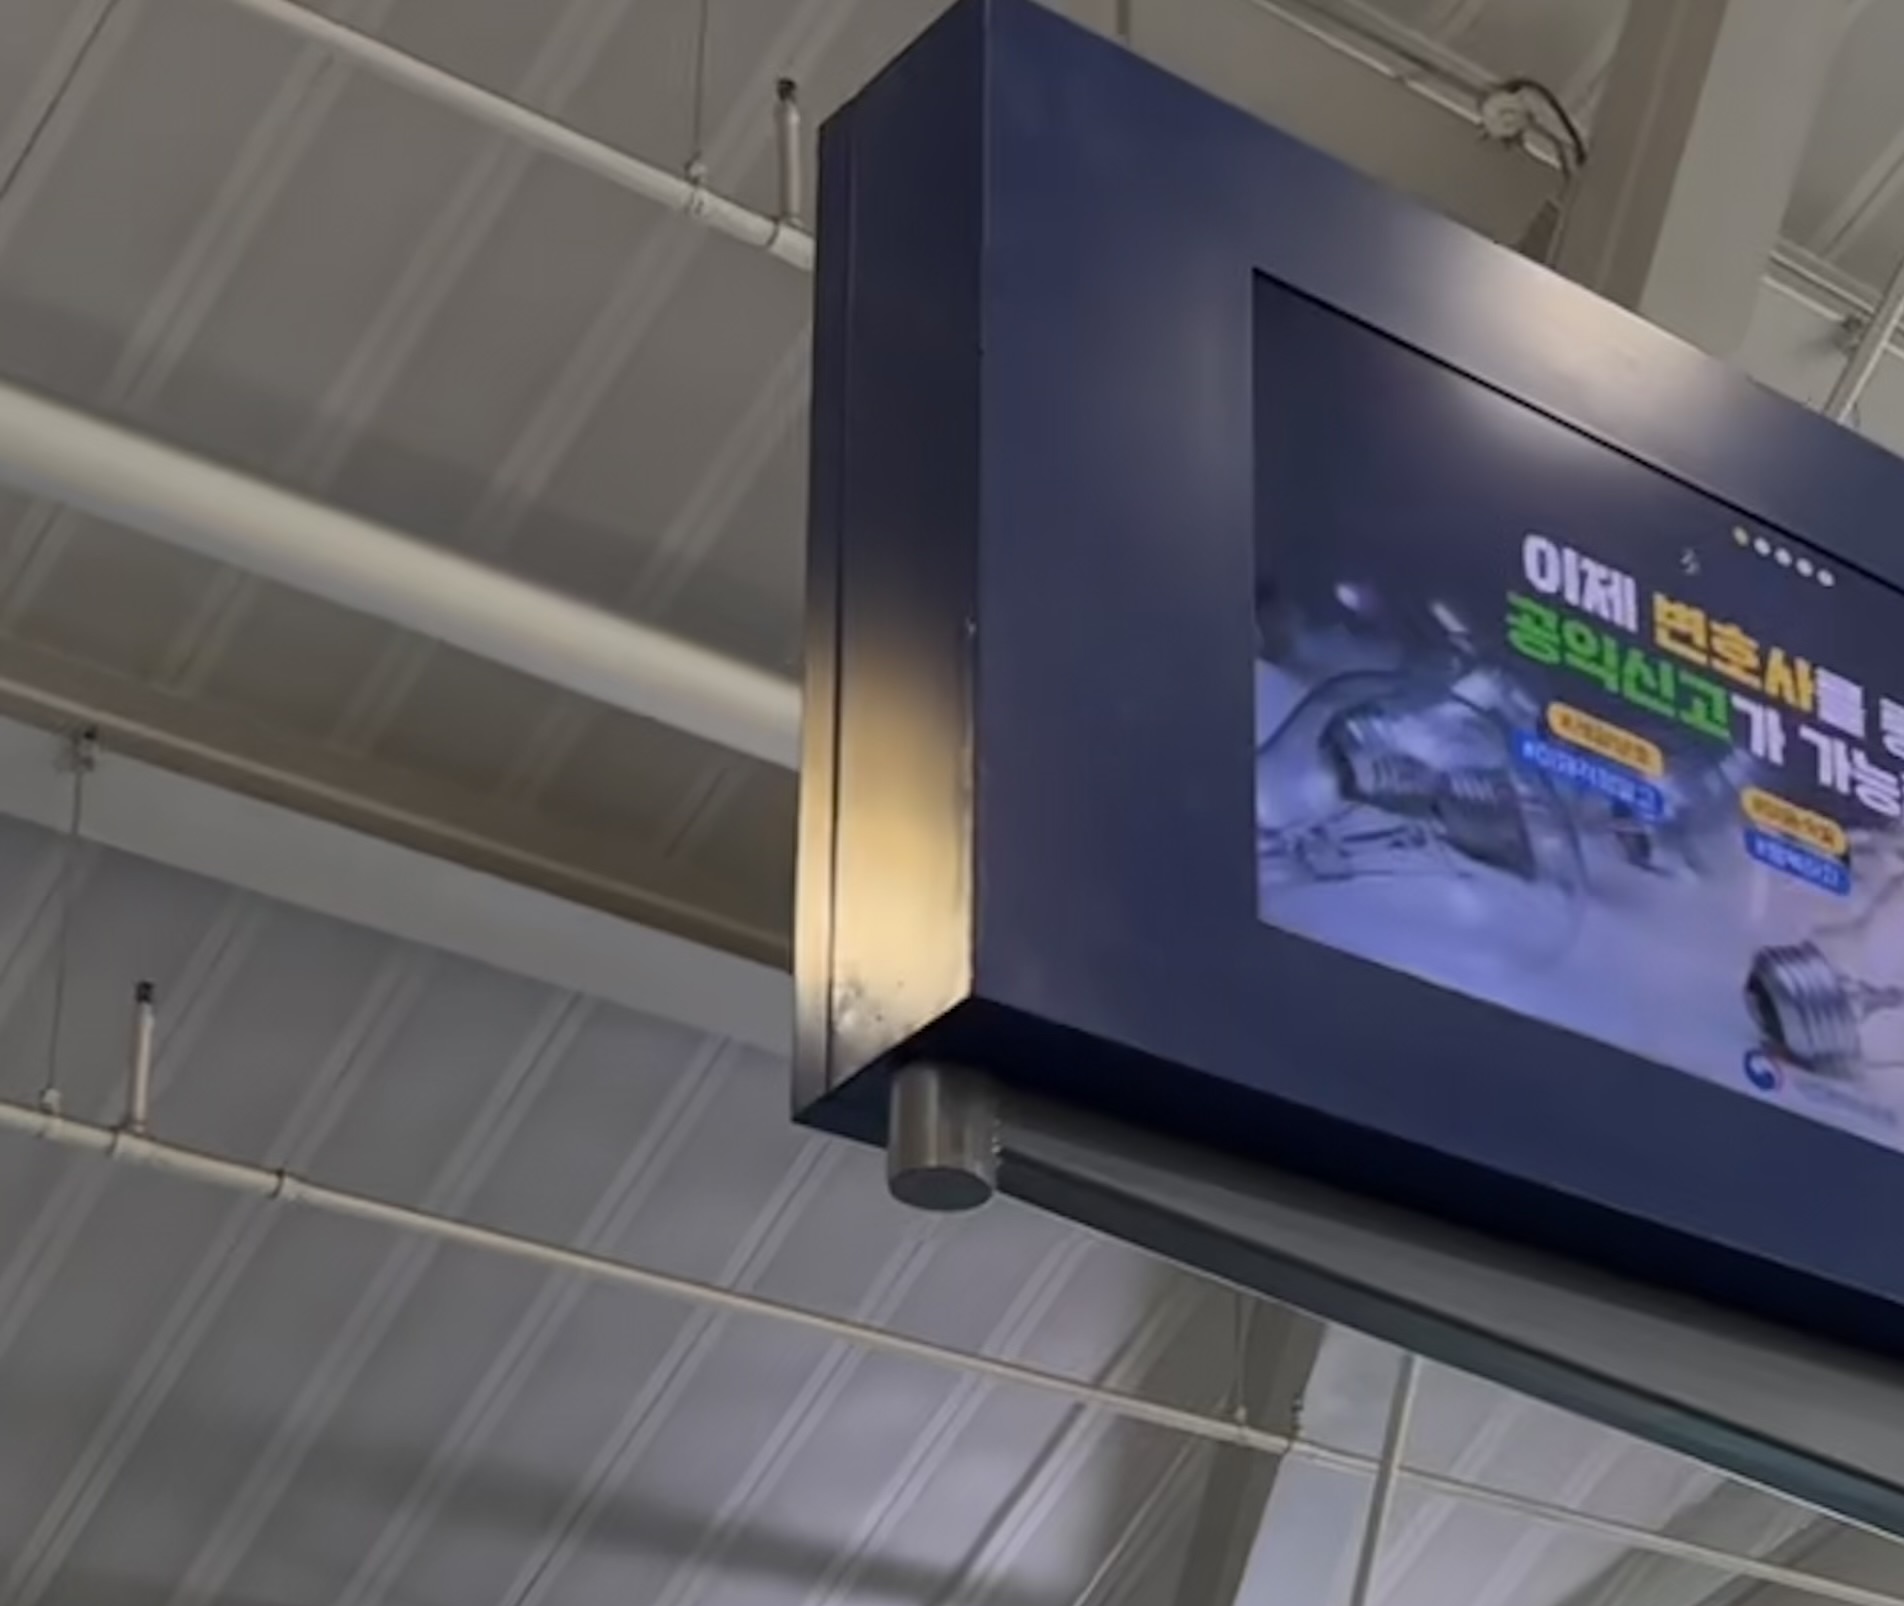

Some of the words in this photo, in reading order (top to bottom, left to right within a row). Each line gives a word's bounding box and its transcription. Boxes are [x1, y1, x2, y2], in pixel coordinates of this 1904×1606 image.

[1506, 589, 1786, 767] 공익신고가
[1522, 533, 1638, 634] 이제
[1652, 590, 1866, 739] 변호사를
